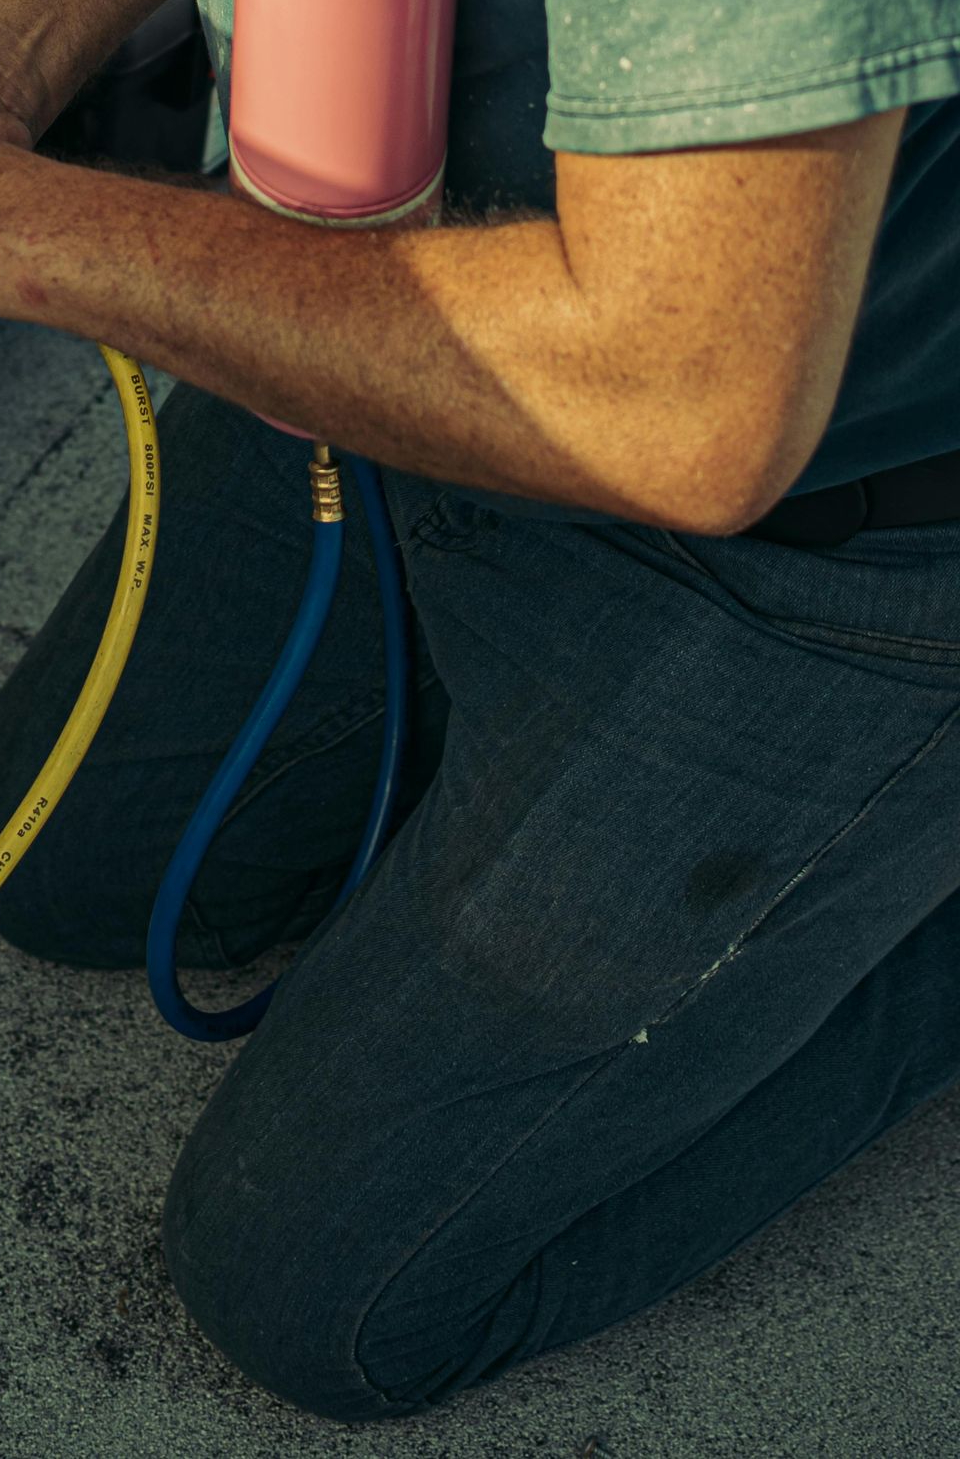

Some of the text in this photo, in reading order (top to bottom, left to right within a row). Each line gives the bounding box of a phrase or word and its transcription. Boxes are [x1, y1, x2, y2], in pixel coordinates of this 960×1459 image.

[130, 374, 155, 591] BURST 800PSI MAX. W.P.
[17, 797, 48, 838] R410a
